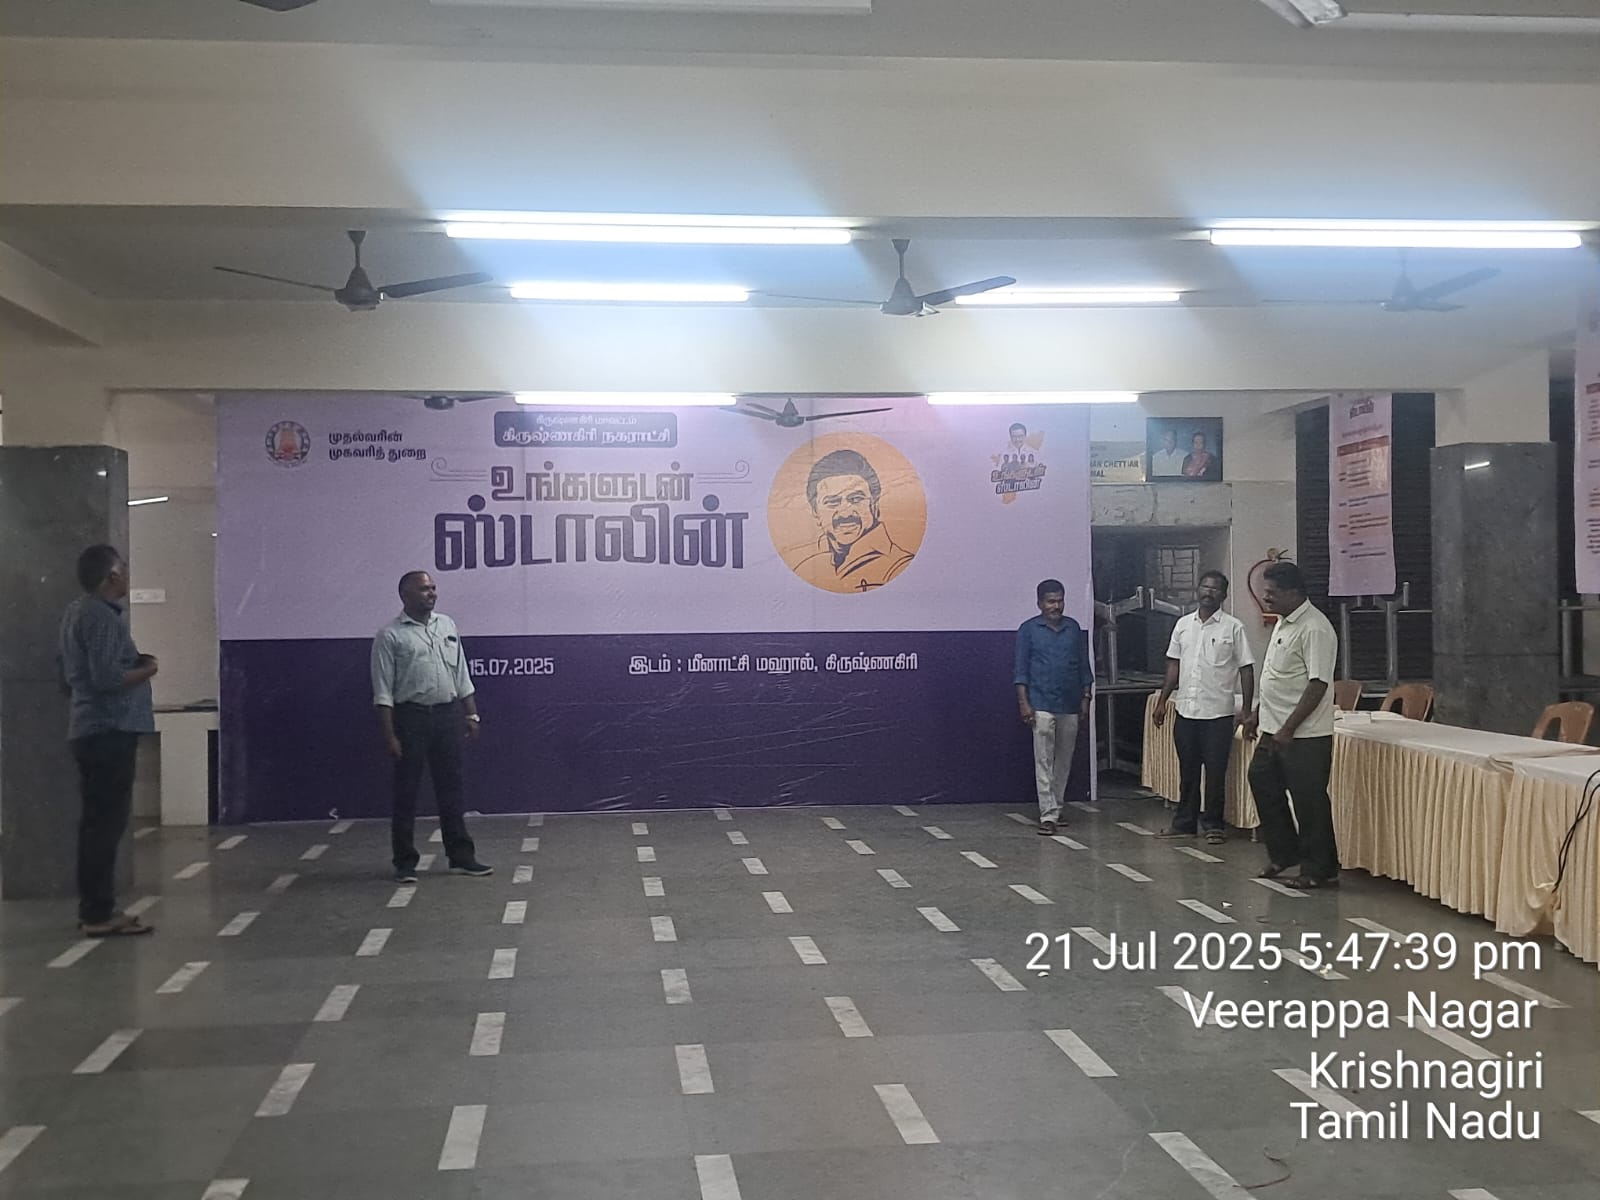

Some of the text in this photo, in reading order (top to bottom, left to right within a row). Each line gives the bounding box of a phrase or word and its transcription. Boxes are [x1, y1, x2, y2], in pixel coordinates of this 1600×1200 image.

[328, 429, 403, 445] முதல்வரின்
[502, 427, 671, 444] கிருஷ்ணகிரி நகராட்சி
[328, 445, 427, 463] முகவரித் துறை
[491, 461, 694, 503] உங்களுடன்
[434, 494, 750, 572] ஸ்டாலின்
[468, 657, 555, 676] 15.07.2025
[628, 654, 672, 675] இடம்
[687, 653, 751, 673] மீனாட்சி
[756, 652, 819, 674] மஹால்,
[825, 651, 919, 673] கிருஷ்ணகிரி
